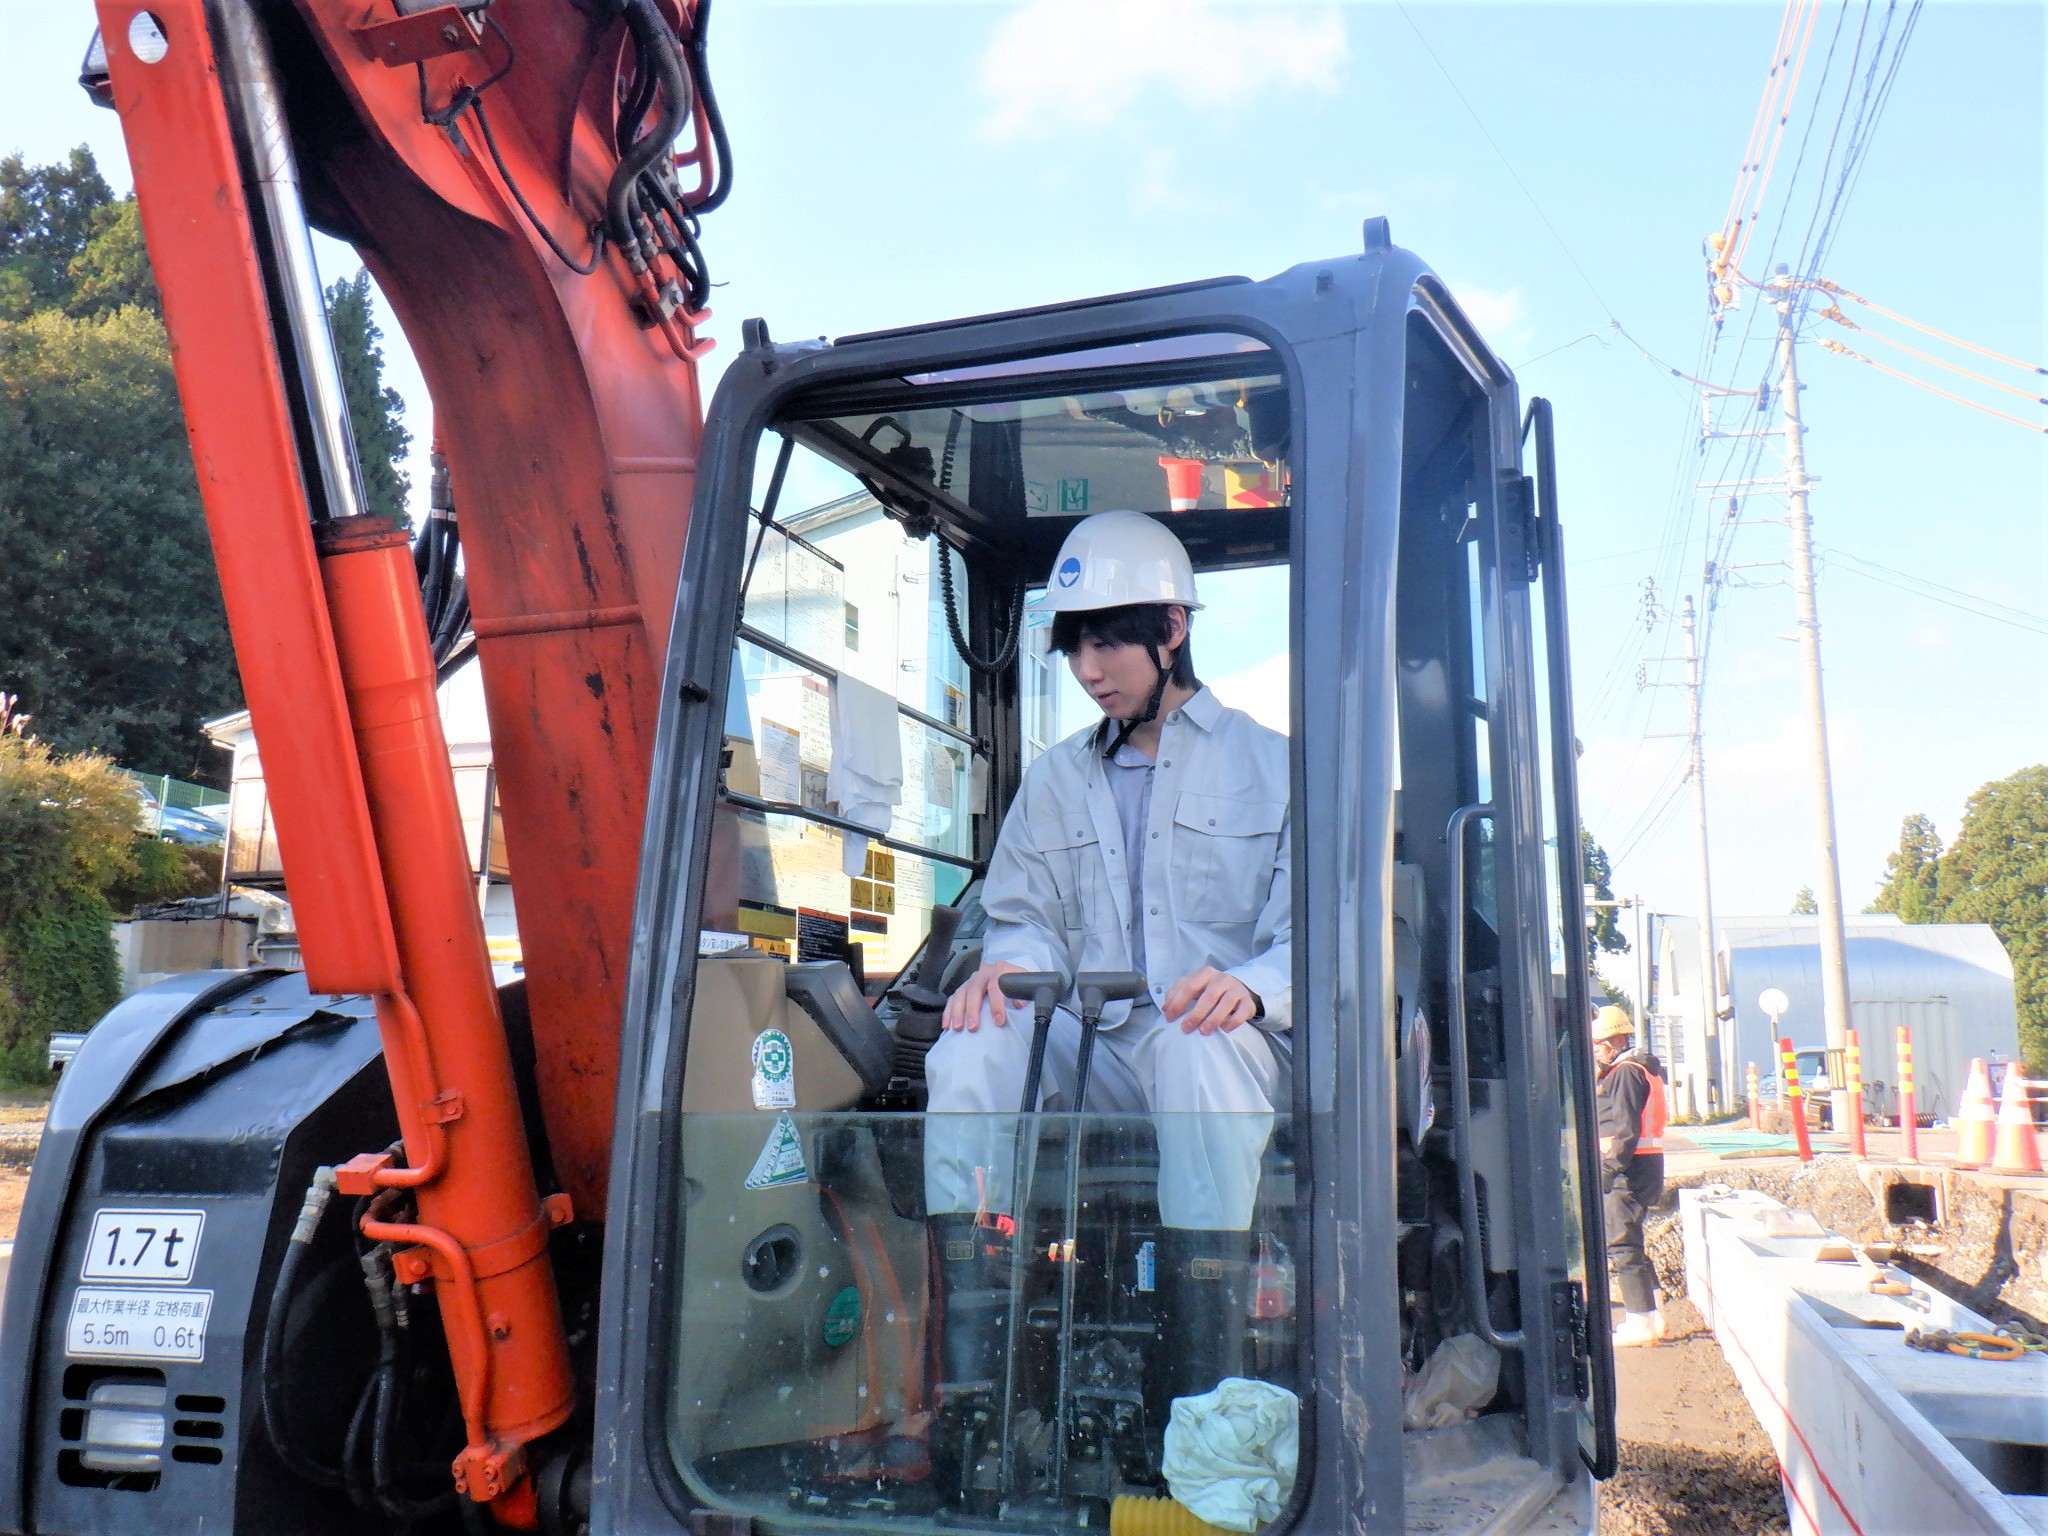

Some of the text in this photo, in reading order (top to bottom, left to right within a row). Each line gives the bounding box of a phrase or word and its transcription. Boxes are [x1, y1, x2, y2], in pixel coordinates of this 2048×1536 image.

[107, 1226, 184, 1268] 1.7t
[76, 1297, 206, 1318] 最大作業半径 定格荷重
[83, 1322, 195, 1349] 5.5m 0.6t
